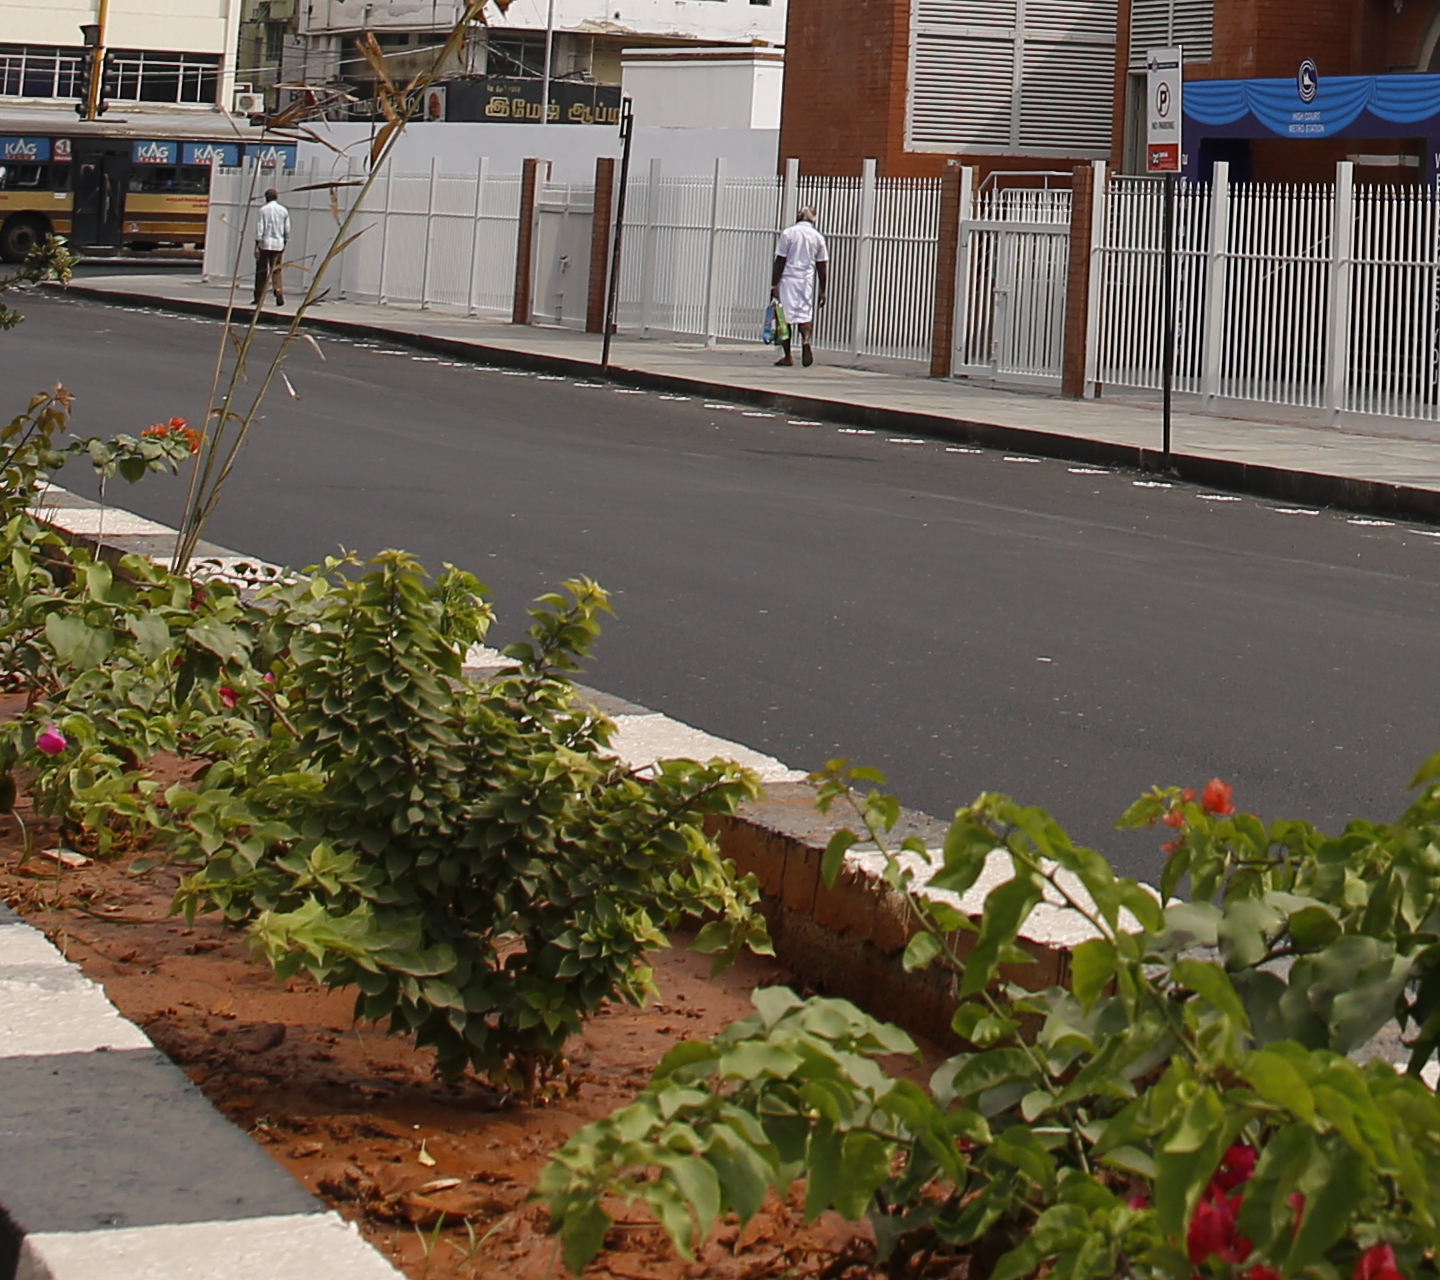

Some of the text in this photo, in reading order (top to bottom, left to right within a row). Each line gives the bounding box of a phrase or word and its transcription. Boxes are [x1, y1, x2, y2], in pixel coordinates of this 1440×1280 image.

[1292, 111, 1321, 121] HIGH COURT
[1151, 122, 1158, 130] NO
[1288, 124, 1325, 133] METRO STATION
[5, 138, 37, 154] KAG
[137, 142, 169, 157] KAG
[194, 144, 225, 159] KAG
